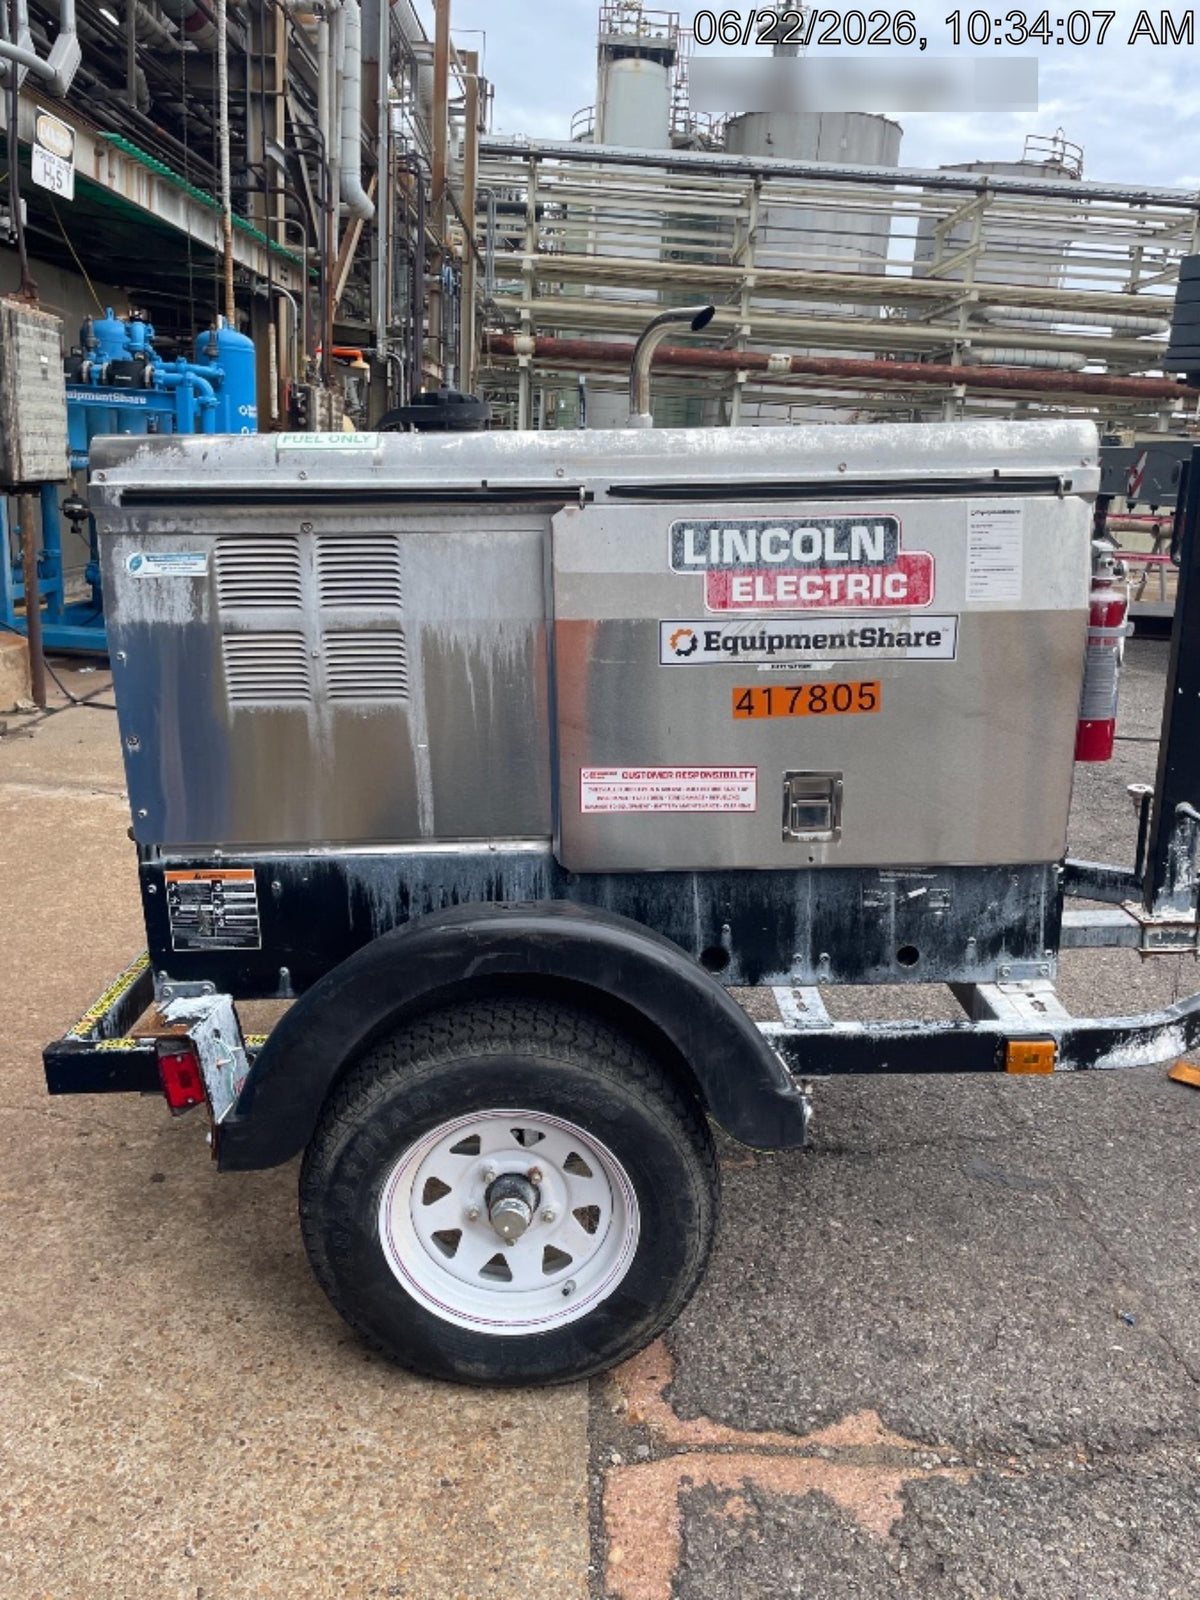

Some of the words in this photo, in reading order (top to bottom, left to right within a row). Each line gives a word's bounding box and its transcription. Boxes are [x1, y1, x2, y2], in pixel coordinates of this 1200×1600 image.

[282, 434, 324, 444] FUEL
[328, 434, 371, 444] ONLY
[683, 525, 885, 565] LINCOLN
[731, 573, 908, 602] ELECTRIC
[703, 627, 942, 656] EquipmentShare
[735, 682, 877, 716] 417805
[621, 770, 673, 780] CUSTOMER
[675, 770, 755, 780] RESPONSIBILITY
